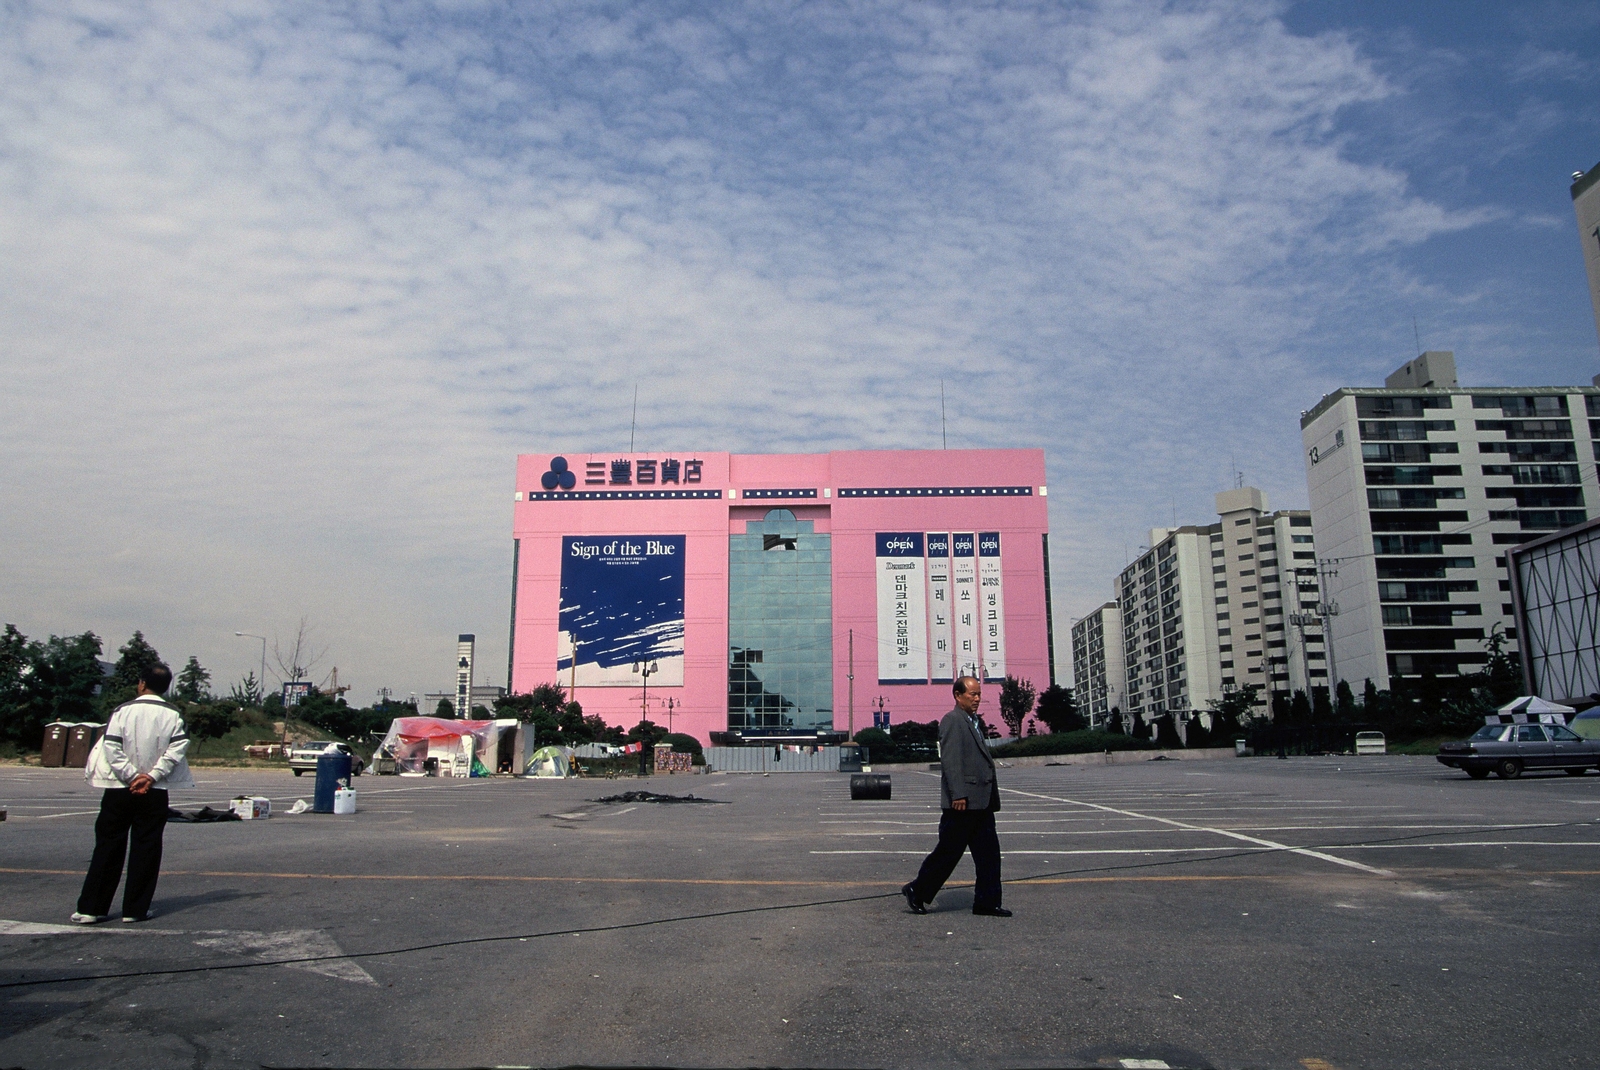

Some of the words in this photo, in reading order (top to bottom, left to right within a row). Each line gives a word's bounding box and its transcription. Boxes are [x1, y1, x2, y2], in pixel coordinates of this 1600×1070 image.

[1309, 446, 1319, 466] 13
[571, 542, 599, 559] Sign
[603, 541, 618, 555] of
[621, 541, 641, 555] the
[646, 541, 675, 555] Blue
[886, 541, 914, 549] OPEN
[929, 542, 947, 550] OPEN
[955, 541, 972, 549] OPEN
[981, 541, 998, 549] OPEN
[895, 574, 908, 600] 덴마크
[895, 601, 908, 618] 치즈
[935, 588, 947, 652] 레노마
[960, 589, 972, 652] 쏘네티
[987, 593, 999, 652] 씽크핑크
[896, 619, 910, 656] 전문매장
